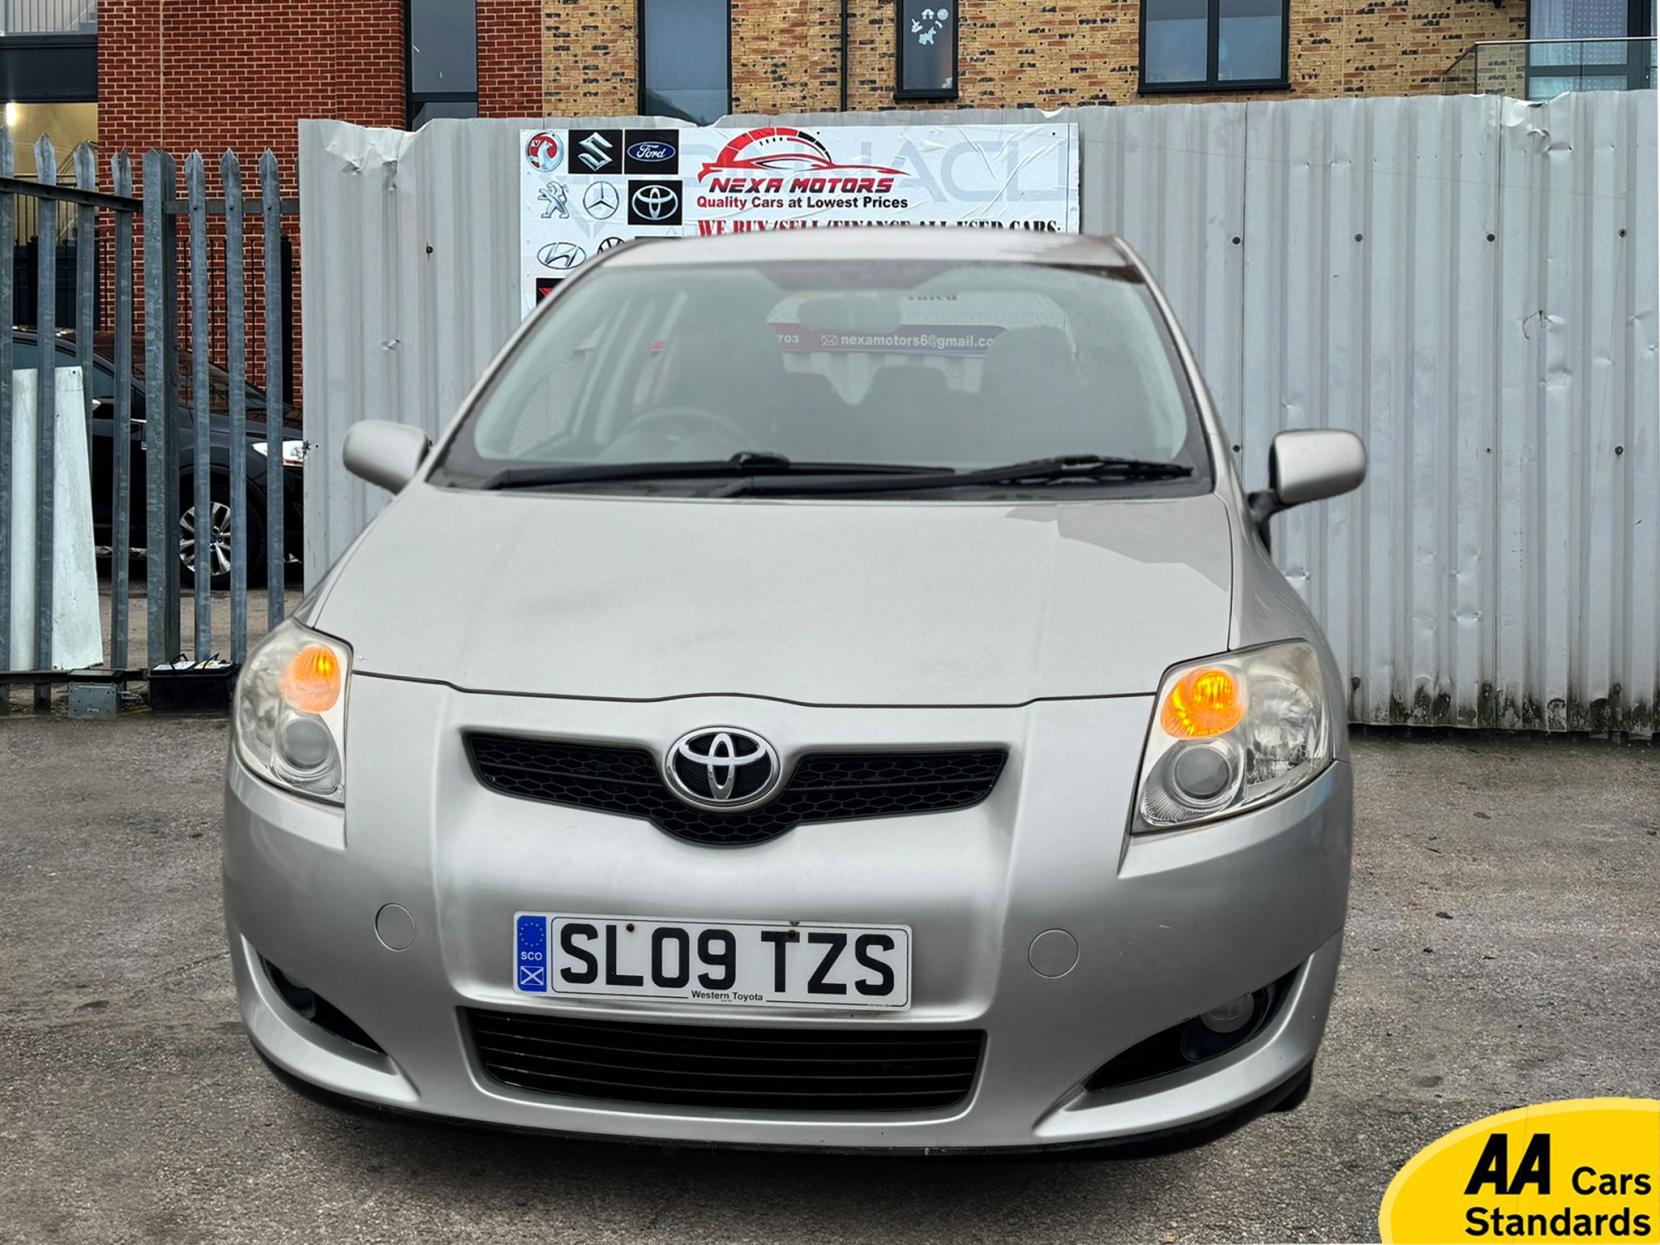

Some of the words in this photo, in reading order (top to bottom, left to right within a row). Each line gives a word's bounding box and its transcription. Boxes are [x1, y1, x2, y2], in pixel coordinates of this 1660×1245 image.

[636, 143, 667, 160] Ford
[709, 177, 784, 194] NEXA
[789, 177, 895, 194] MOTORS
[696, 196, 747, 210] Quality
[751, 196, 784, 208] Cars
[788, 196, 802, 208] at
[807, 196, 859, 208] Lowest
[863, 196, 908, 208] Prices
[520, 951, 543, 961] SCO
[560, 923, 736, 989] SL09
[761, 931, 895, 997] TZS
[691, 990, 730, 1000] Western
[732, 992, 763, 1002] Toyota
